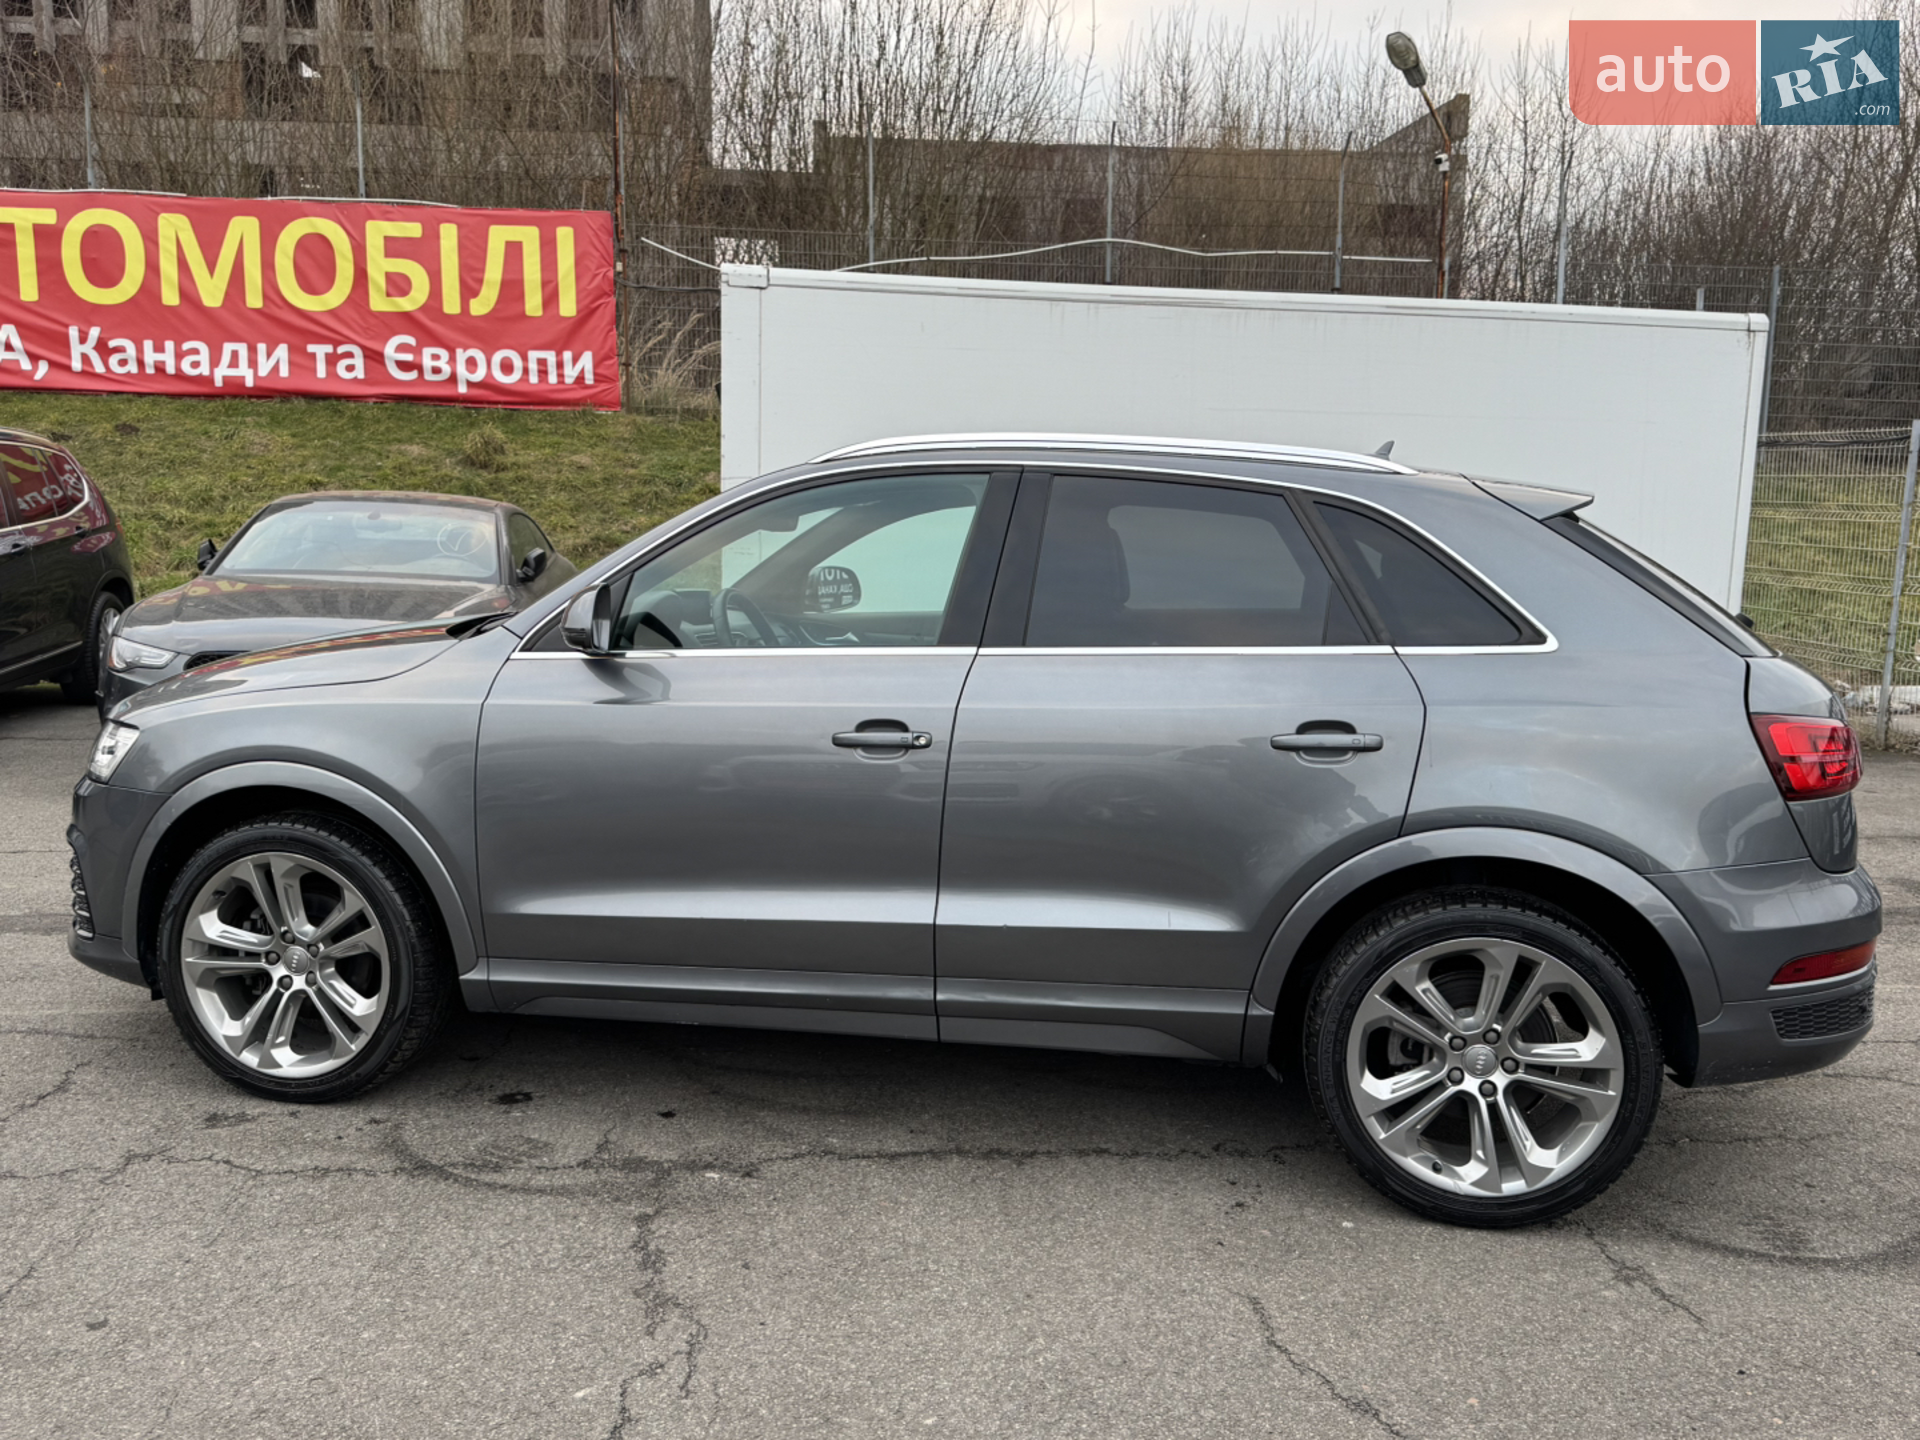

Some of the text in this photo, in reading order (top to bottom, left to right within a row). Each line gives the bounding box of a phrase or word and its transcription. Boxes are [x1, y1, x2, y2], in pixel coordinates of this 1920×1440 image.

[68, 325, 290, 387] Канади
[307, 344, 366, 380] та
[384, 334, 595, 394] Європи
